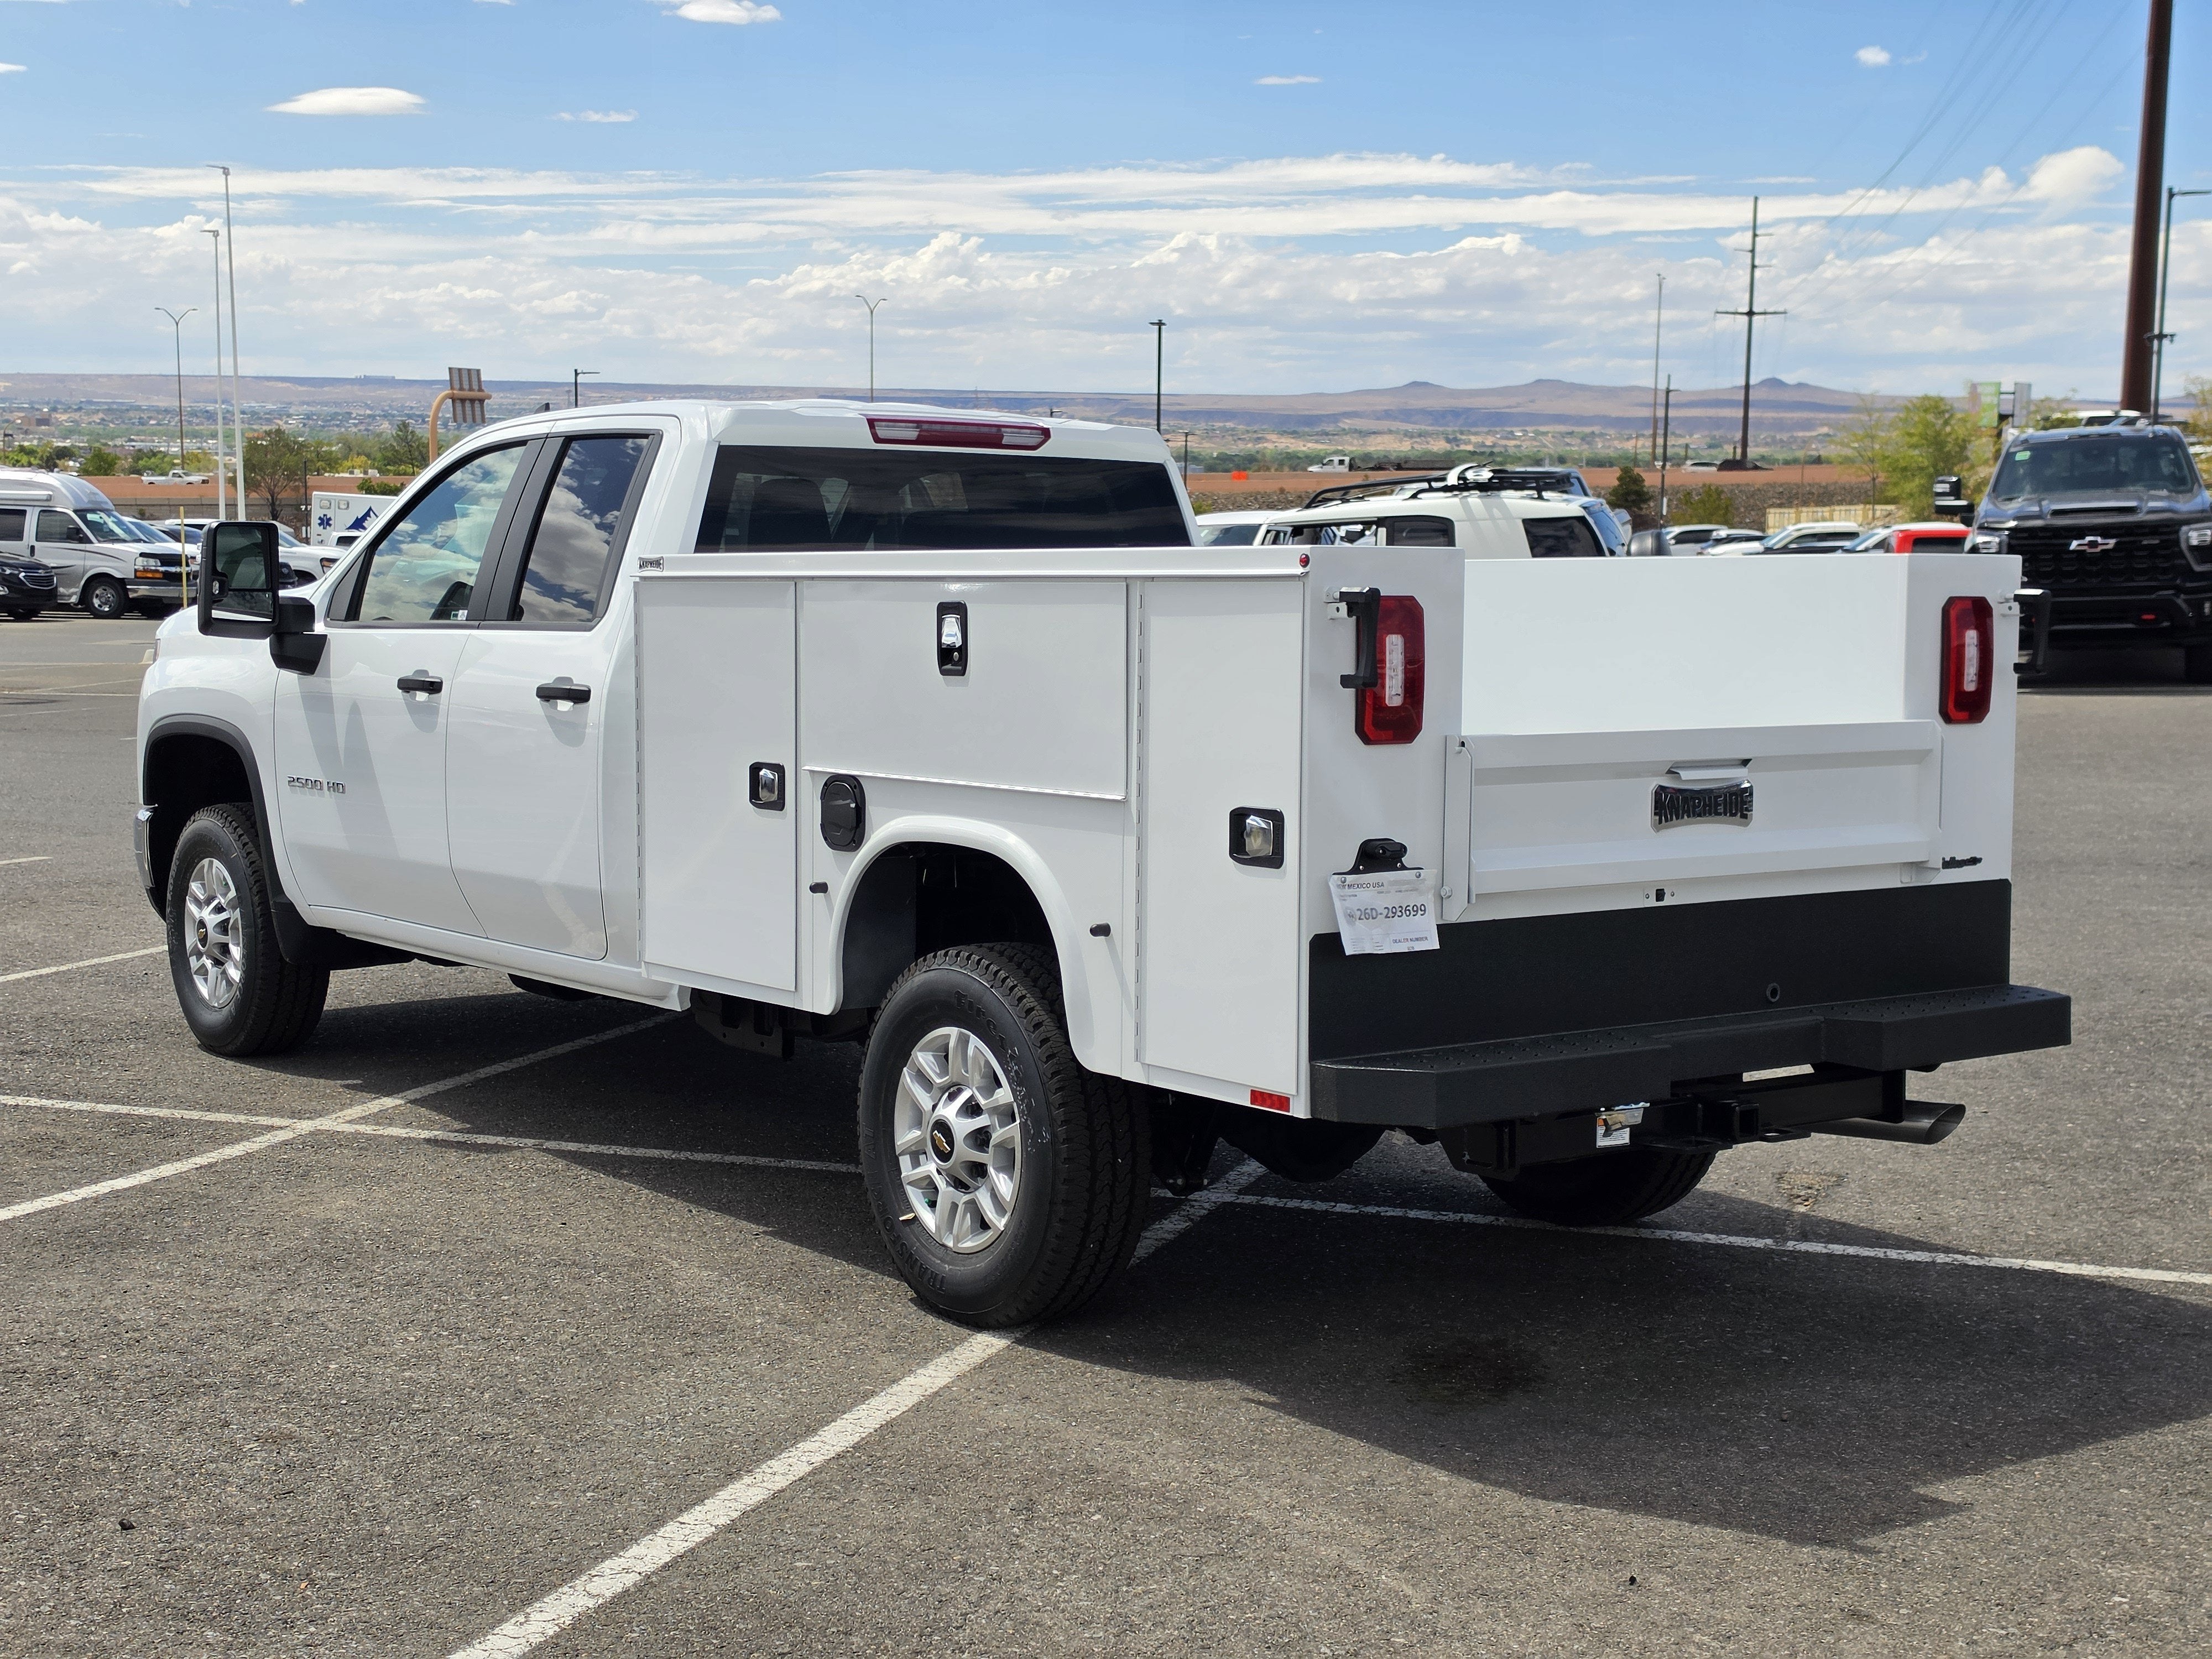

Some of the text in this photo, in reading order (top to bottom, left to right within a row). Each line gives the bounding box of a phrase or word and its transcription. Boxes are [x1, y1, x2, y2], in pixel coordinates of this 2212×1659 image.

[287, 775, 346, 794] 2500 HD
[1657, 787, 1749, 825] KNAPHEIDE
[1357, 903, 1427, 921] 26D-293699
